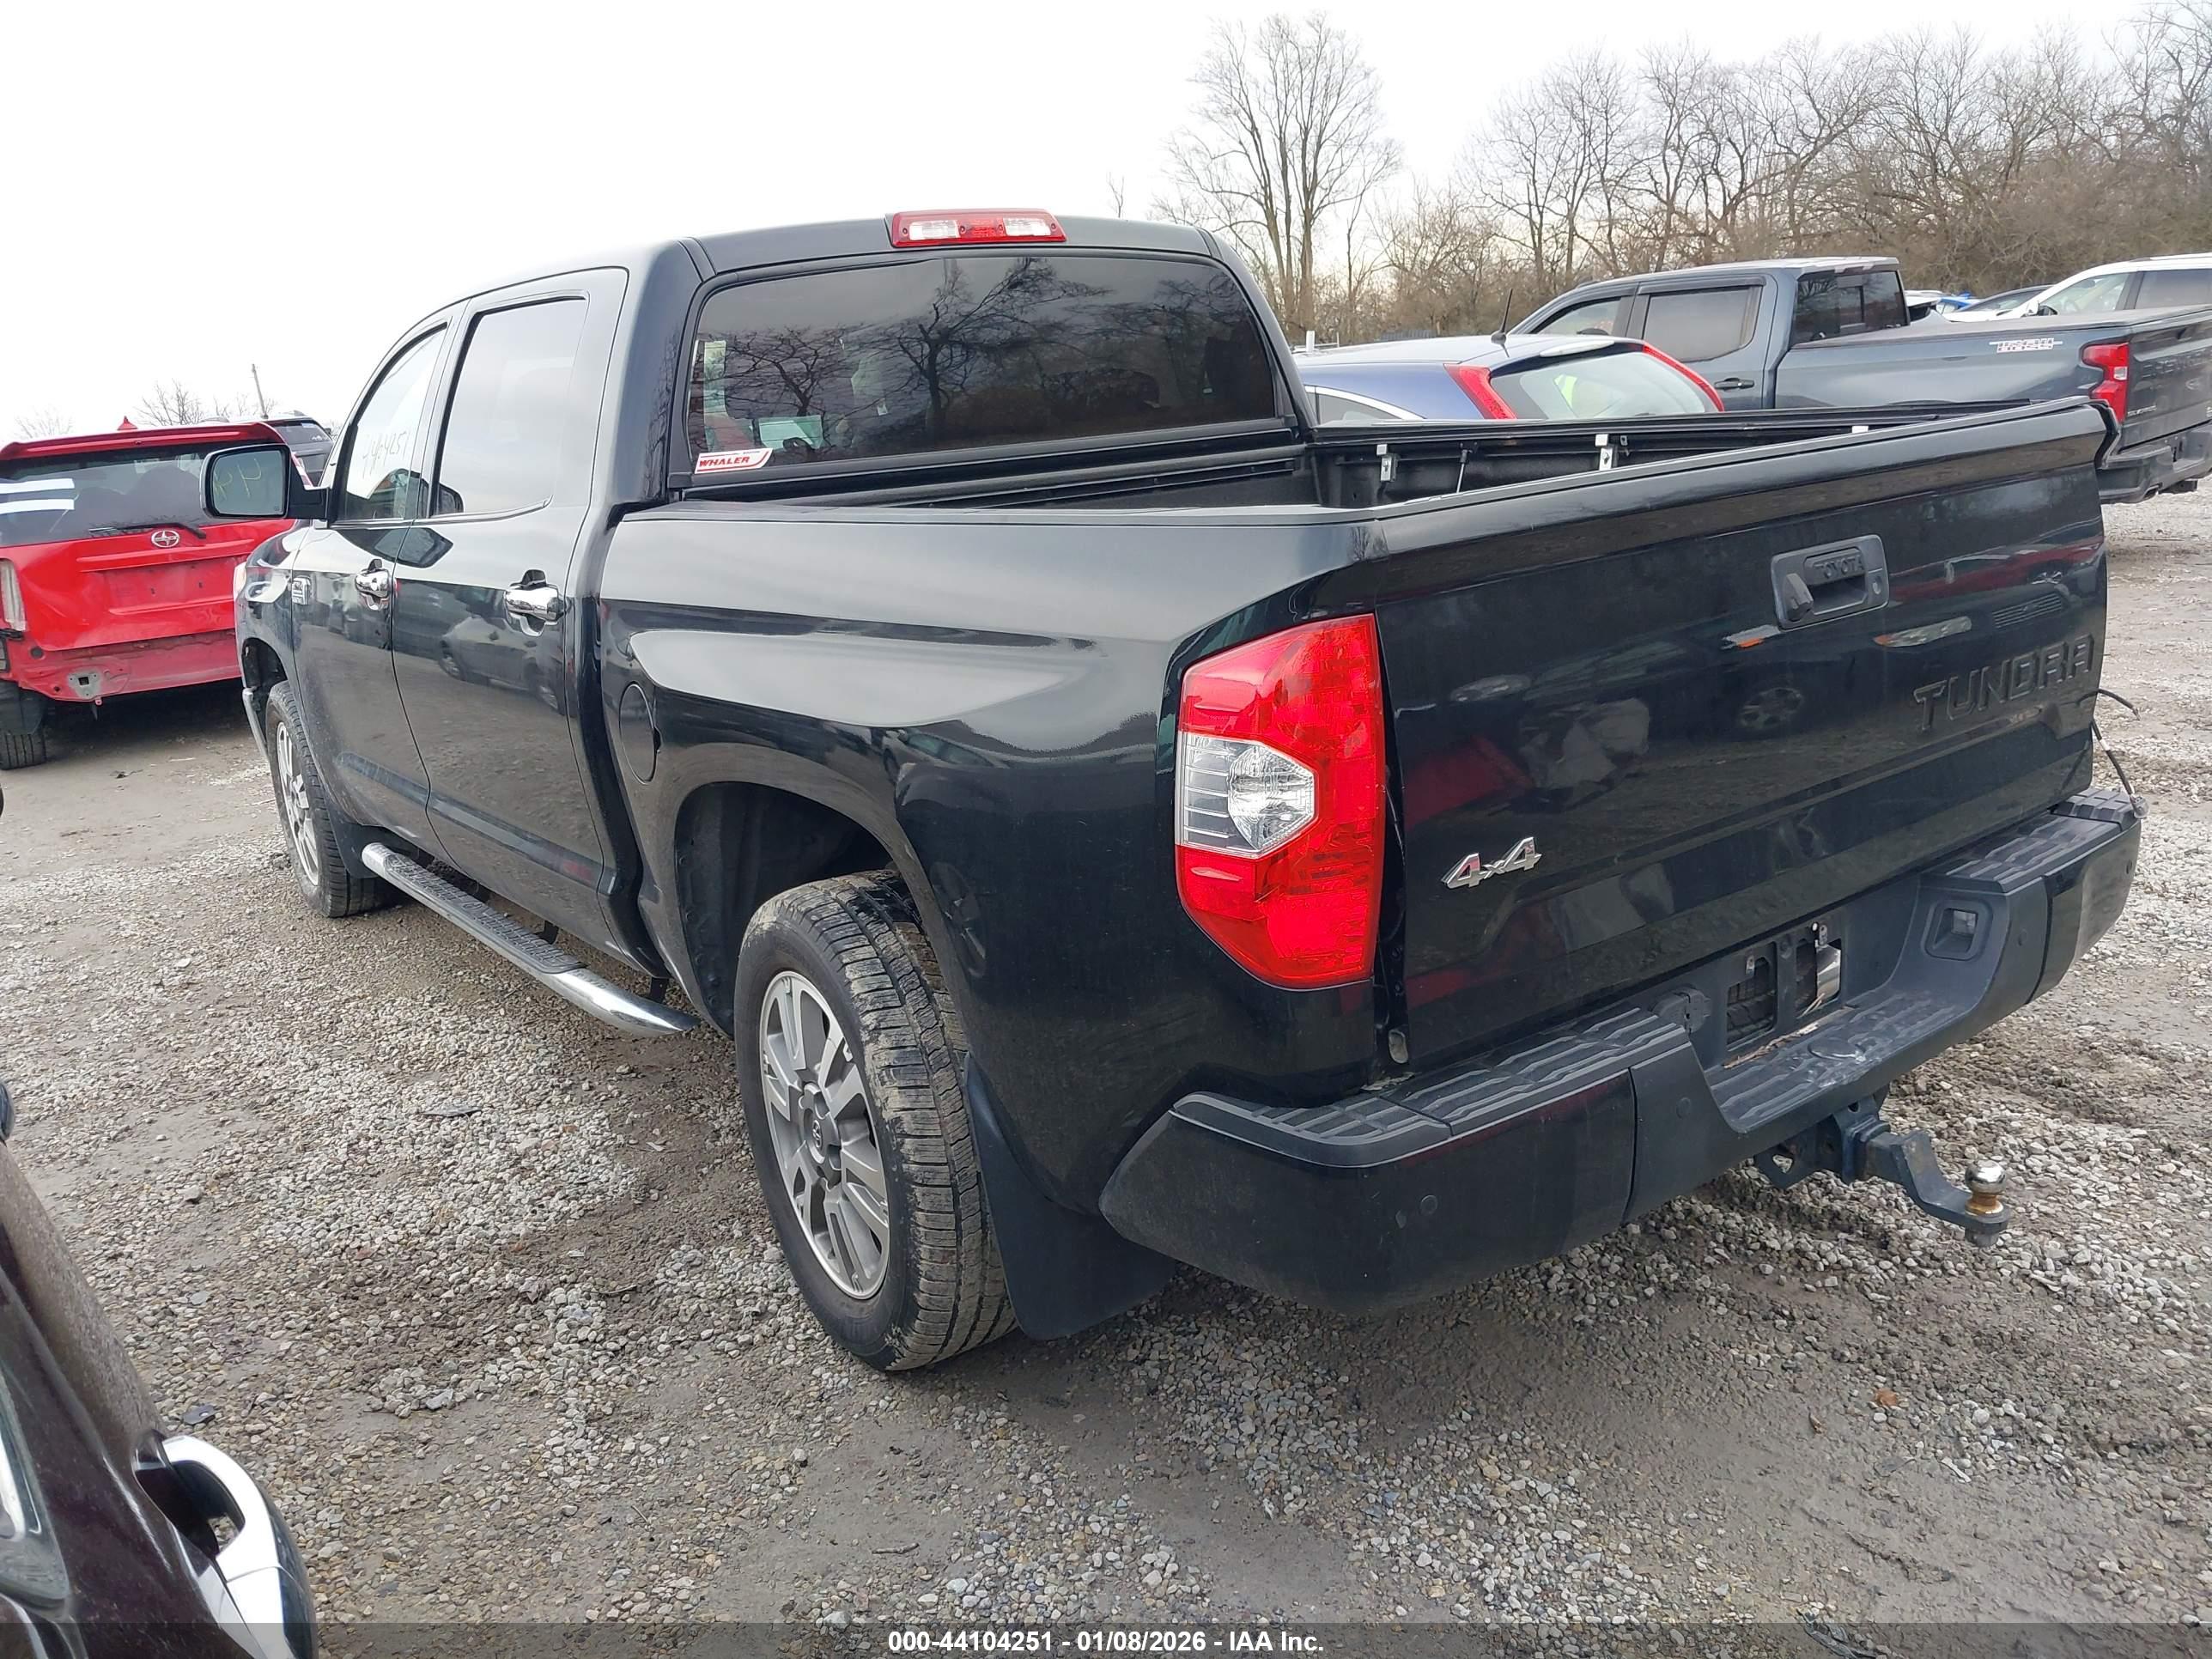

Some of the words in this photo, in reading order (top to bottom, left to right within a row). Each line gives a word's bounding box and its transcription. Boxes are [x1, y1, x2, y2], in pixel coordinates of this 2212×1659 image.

[699, 456, 750, 468] WHALER
[1813, 553, 1865, 580] TOYOTA
[1913, 634, 2094, 731] TUNDRA
